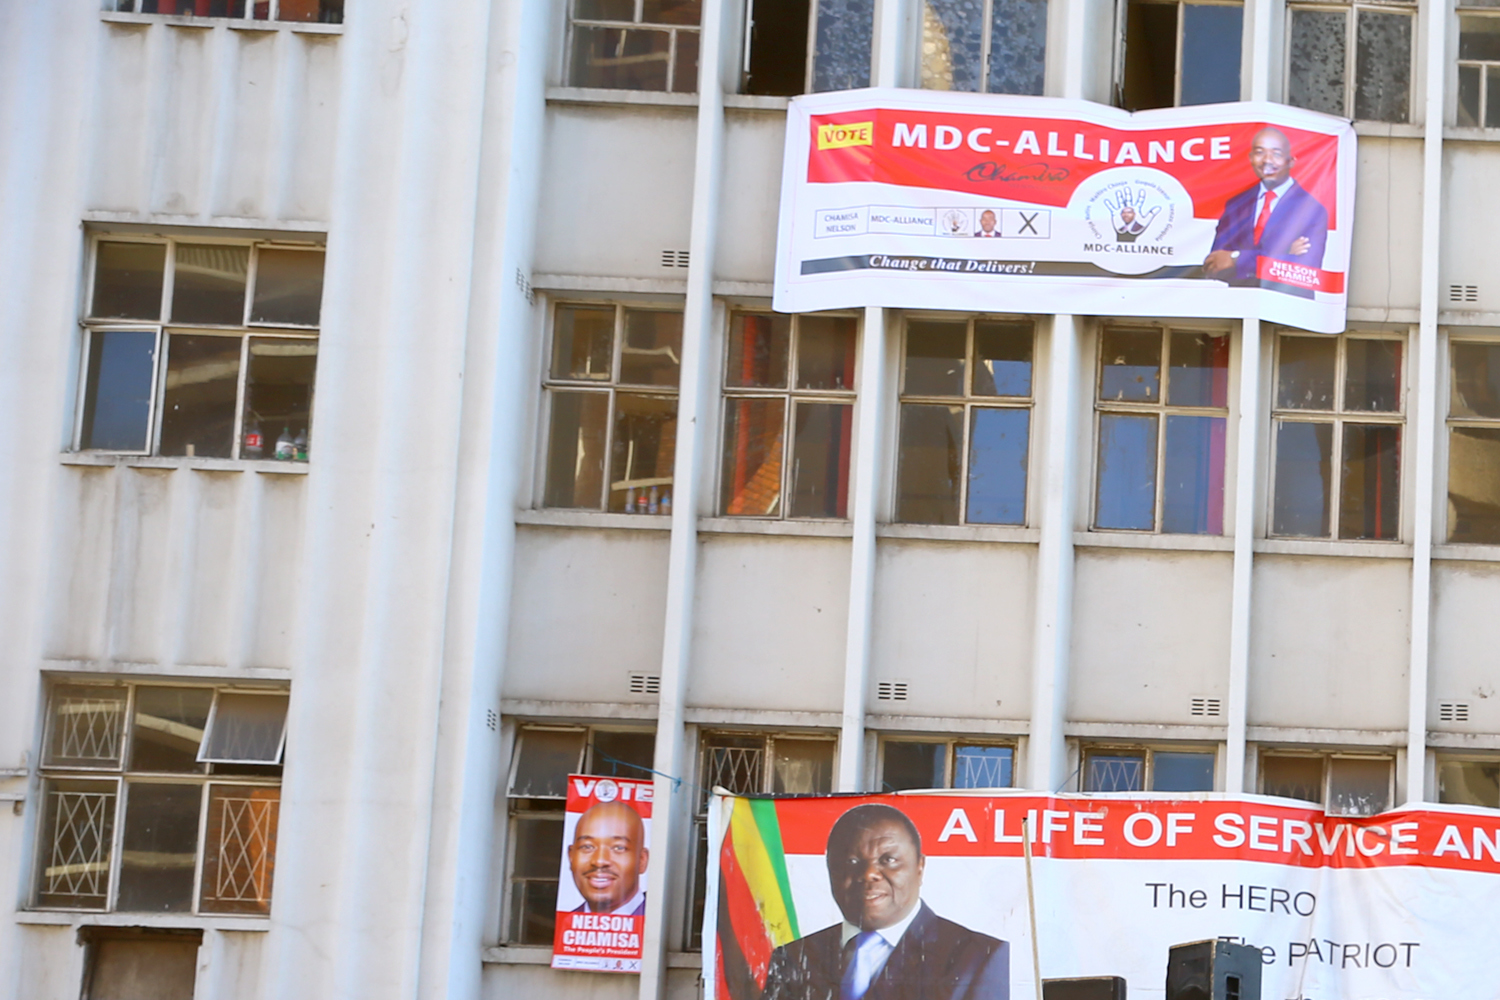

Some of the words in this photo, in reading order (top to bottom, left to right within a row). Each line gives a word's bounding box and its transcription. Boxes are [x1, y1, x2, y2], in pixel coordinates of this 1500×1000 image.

[824, 128, 867, 143] VOTE
[892, 122, 1232, 164] MDC-ALLIANCE
[824, 212, 859, 222] CHAMISA
[871, 215, 934, 226] MDC-ALLIANCE
[826, 224, 857, 233] NELSON
[1083, 243, 1174, 255] MDC-ALLIANCE
[869, 255, 926, 271] Change
[930, 258, 961, 271] that
[965, 260, 1036, 274] Delivers!
[1273, 261, 1317, 277] NELSON
[1269, 268, 1320, 285] CHAMISA
[573, 779, 653, 803] VOTE
[938, 808, 978, 843] A
[994, 808, 1105, 846] LIFE
[1123, 812, 1196, 848] OF
[1212, 812, 1419, 857] SERVICE
[1145, 882, 1208, 909] The
[1221, 884, 1316, 917] HERO
[572, 914, 634, 932] NELSON
[563, 930, 640, 948] CHAMISA
[606, 947, 638, 955] President
[1288, 938, 1420, 969] PATRIOT
